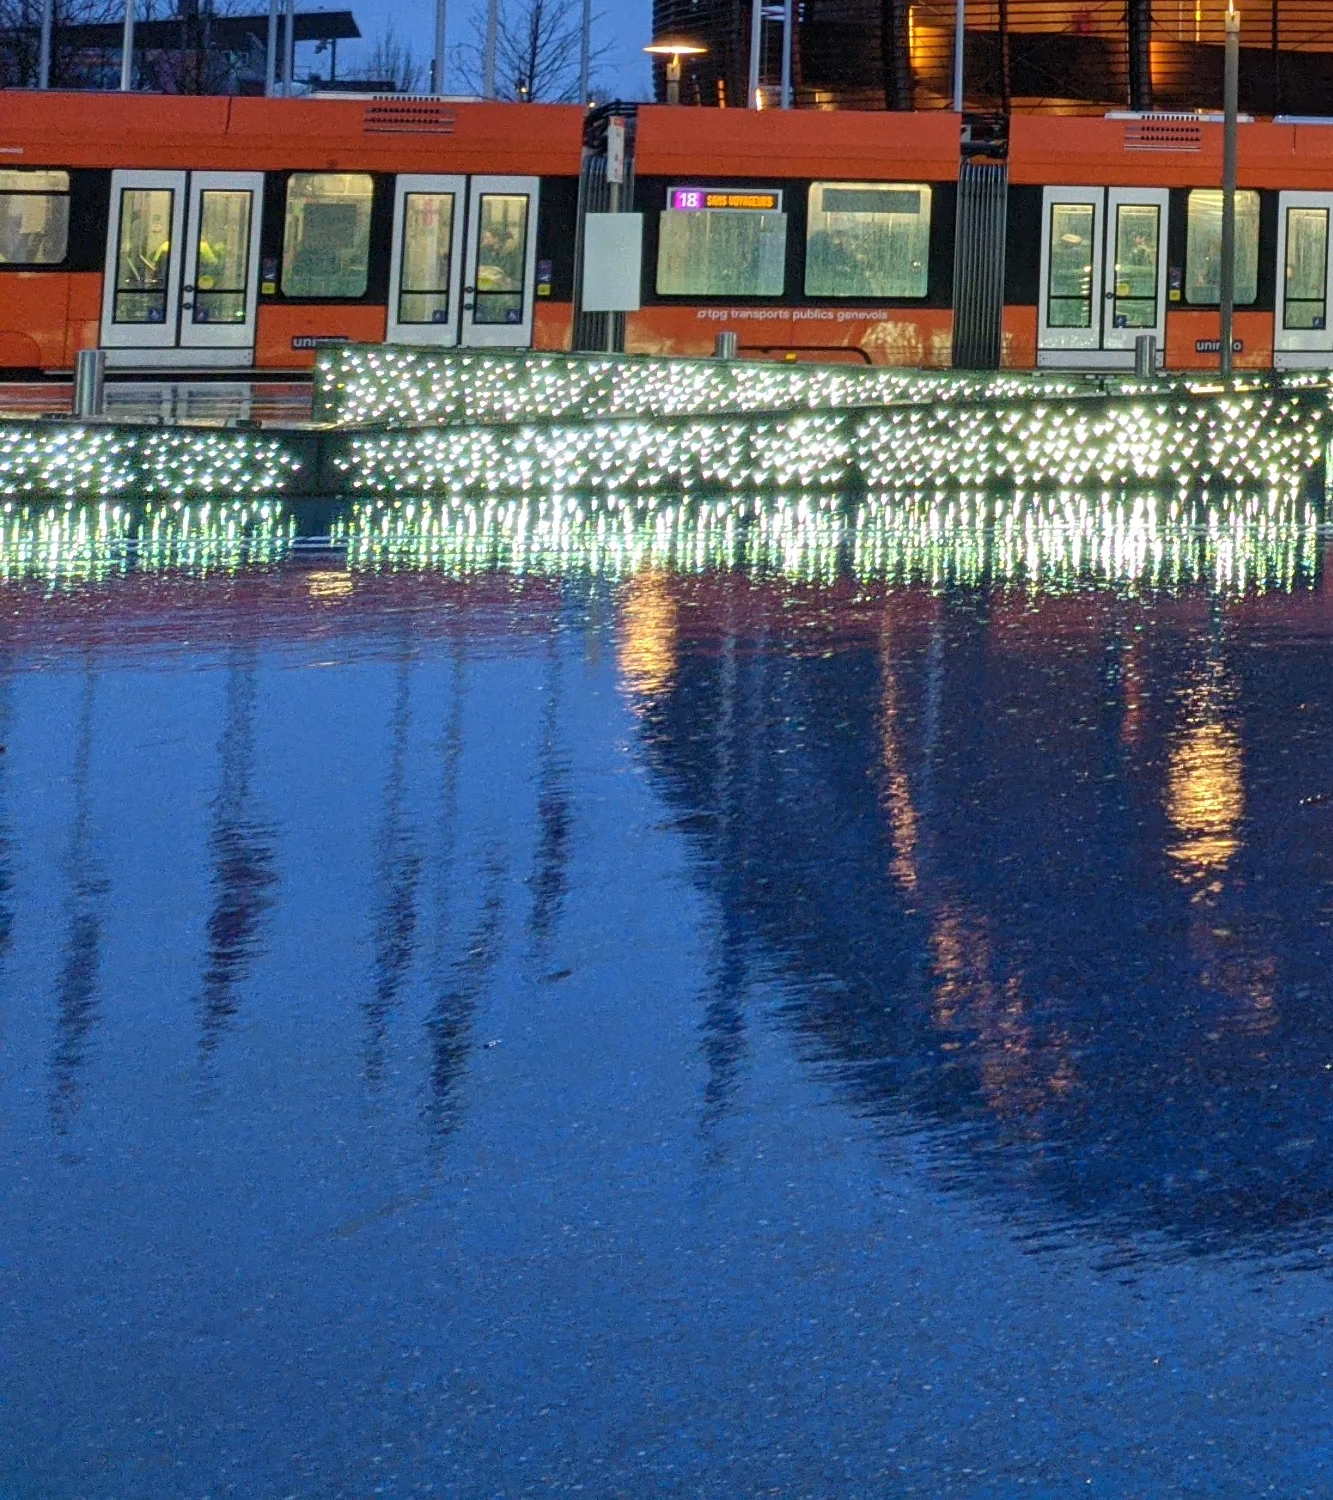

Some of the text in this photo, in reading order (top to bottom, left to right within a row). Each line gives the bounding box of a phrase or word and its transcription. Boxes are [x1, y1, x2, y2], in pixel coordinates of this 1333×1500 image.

[679, 192, 698, 207] 18
[708, 308, 888, 322] tpg transports publics genevois
